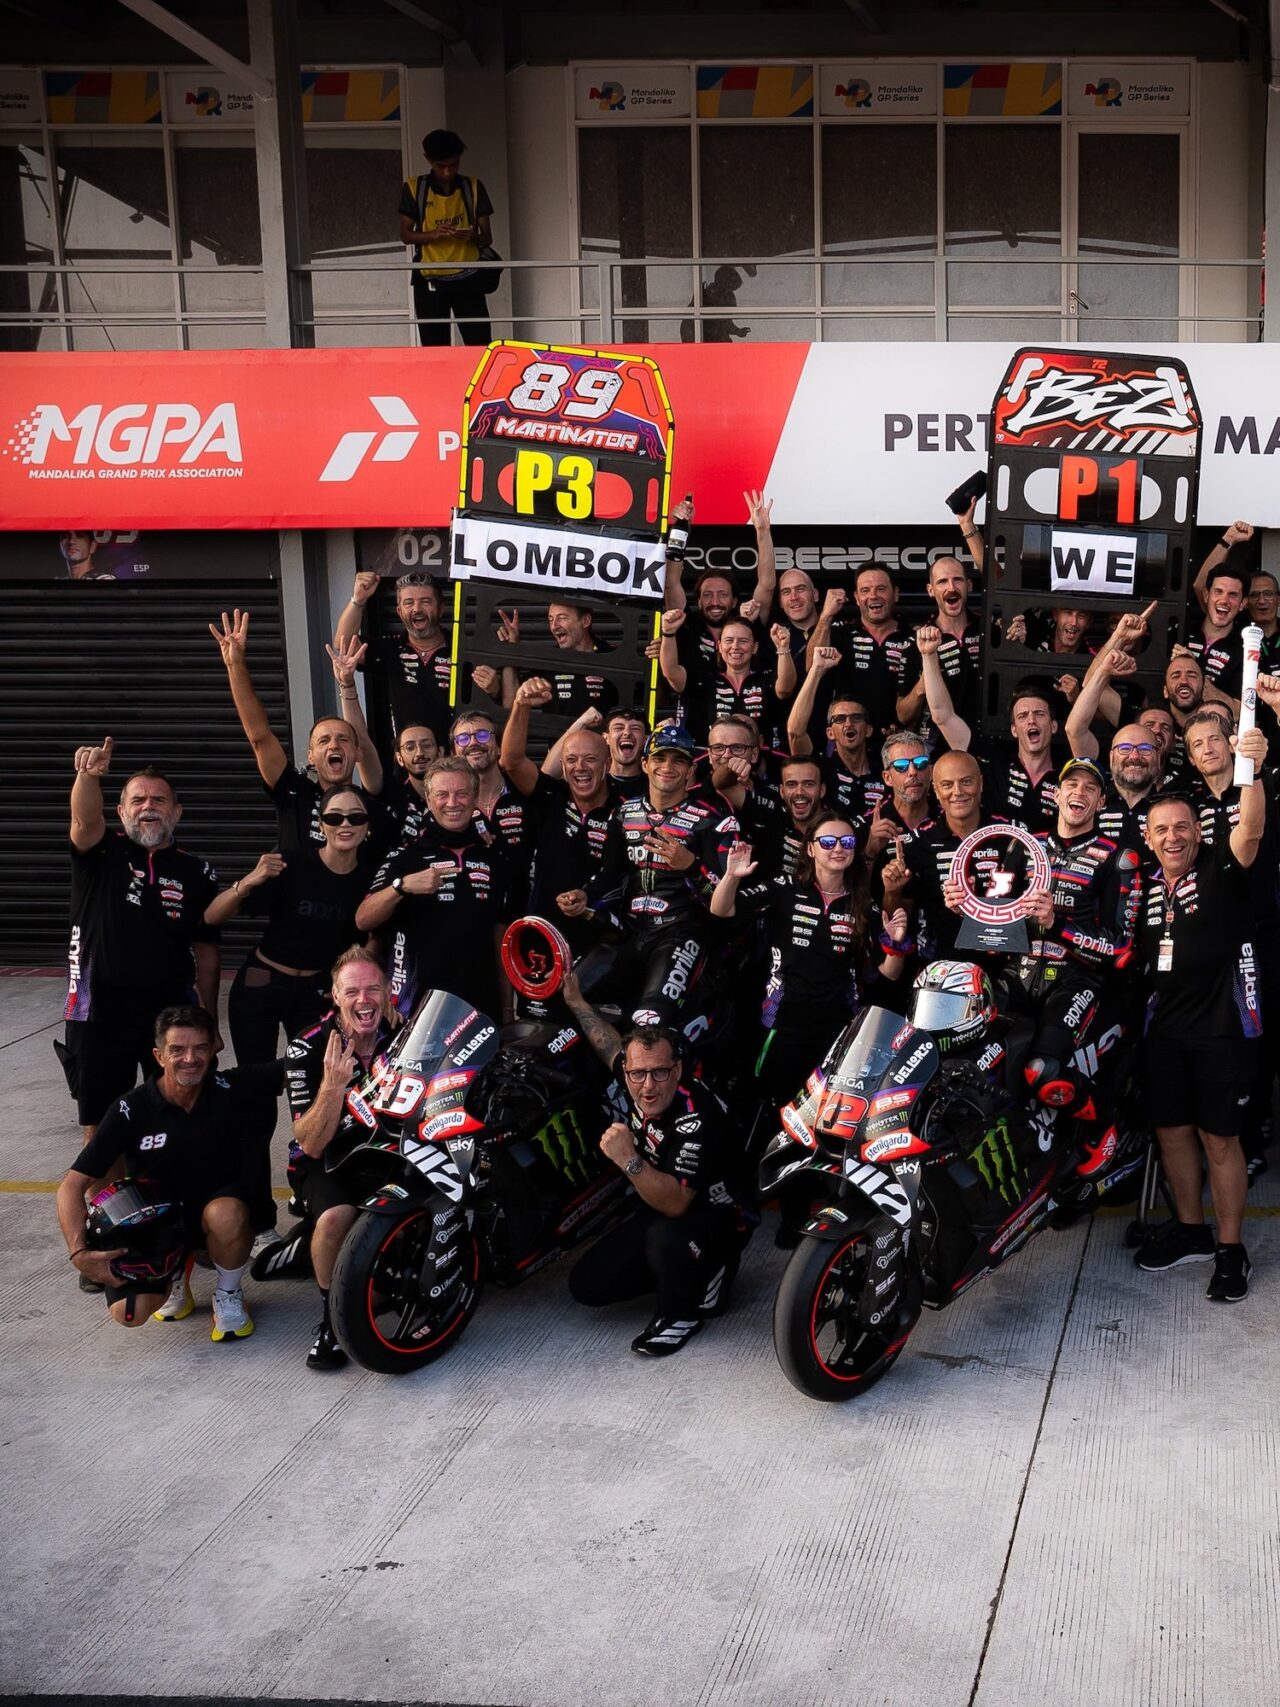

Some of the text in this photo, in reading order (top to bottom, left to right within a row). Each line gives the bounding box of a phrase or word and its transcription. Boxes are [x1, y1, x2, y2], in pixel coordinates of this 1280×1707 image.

[630, 97, 645, 105] GP
[631, 88, 676, 97] Mandalika
[877, 94, 892, 102] GP
[878, 86, 924, 94] Mandalika
[1127, 93, 1142, 101] GP
[1128, 85, 1174, 93] Mandalika
[508, 361, 625, 420] 89
[29, 402, 243, 464] MGPA
[496, 416, 639, 450] MARTINATOR
[28, 467, 244, 479] MANDALIKA GRAND PRIX ASSOCIATION
[516, 450, 595, 520] P3
[1058, 455, 1139, 524] P1
[398, 533, 443, 567] 02
[453, 533, 666, 593] LOMBOK
[684, 547, 758, 570] RCO
[133, 563, 150, 573] ESP
[1053, 546, 1136, 585] WE
[496, 805, 524, 817] aprilia
[1072, 931, 1115, 957] aprilia
[67, 925, 83, 995] aprilia
[391, 931, 407, 996] aprilia
[662, 939, 701, 1001] aprilia
[1238, 942, 1258, 1010] aprilia
[1063, 988, 1095, 1029] aprilia
[547, 1027, 579, 1055] aprilia
[977, 1041, 1005, 1072] aprilia
[423, 1111, 463, 1139] sterilgarda
[139, 1132, 168, 1151] 89
[450, 1137, 474, 1152] sky
[866, 1133, 911, 1160] sterilgarda
[895, 1160, 920, 1176] sky
